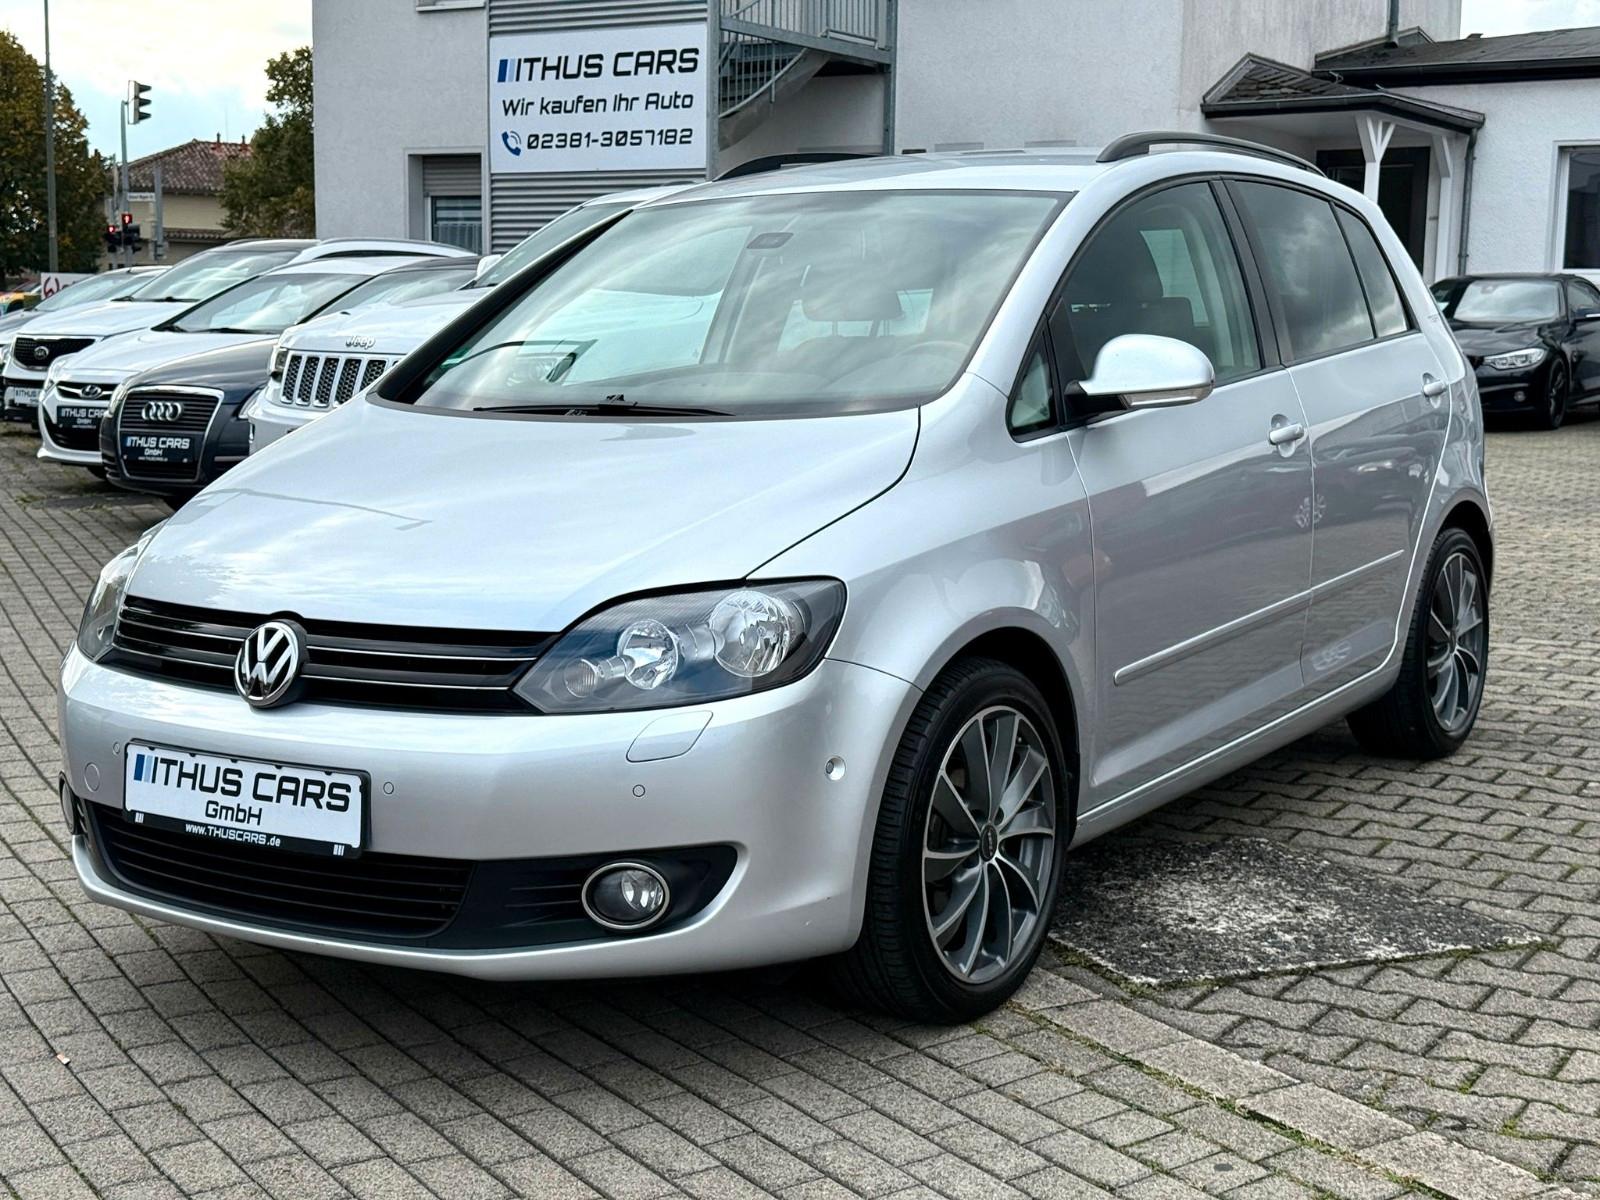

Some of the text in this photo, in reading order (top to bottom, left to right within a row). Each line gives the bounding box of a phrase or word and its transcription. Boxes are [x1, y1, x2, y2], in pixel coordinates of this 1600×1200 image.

[613, 48, 700, 77] CARS
[502, 91, 694, 116] Wir kaufen Ihr Auto
[527, 128, 693, 149] 02381-3057182
[345, 335, 376, 349] Jeep
[158, 437, 190, 449] CARS
[252, 772, 351, 813] CARS
[205, 800, 263, 826] GmbH
[185, 823, 281, 847] www.THUSCARS.de
